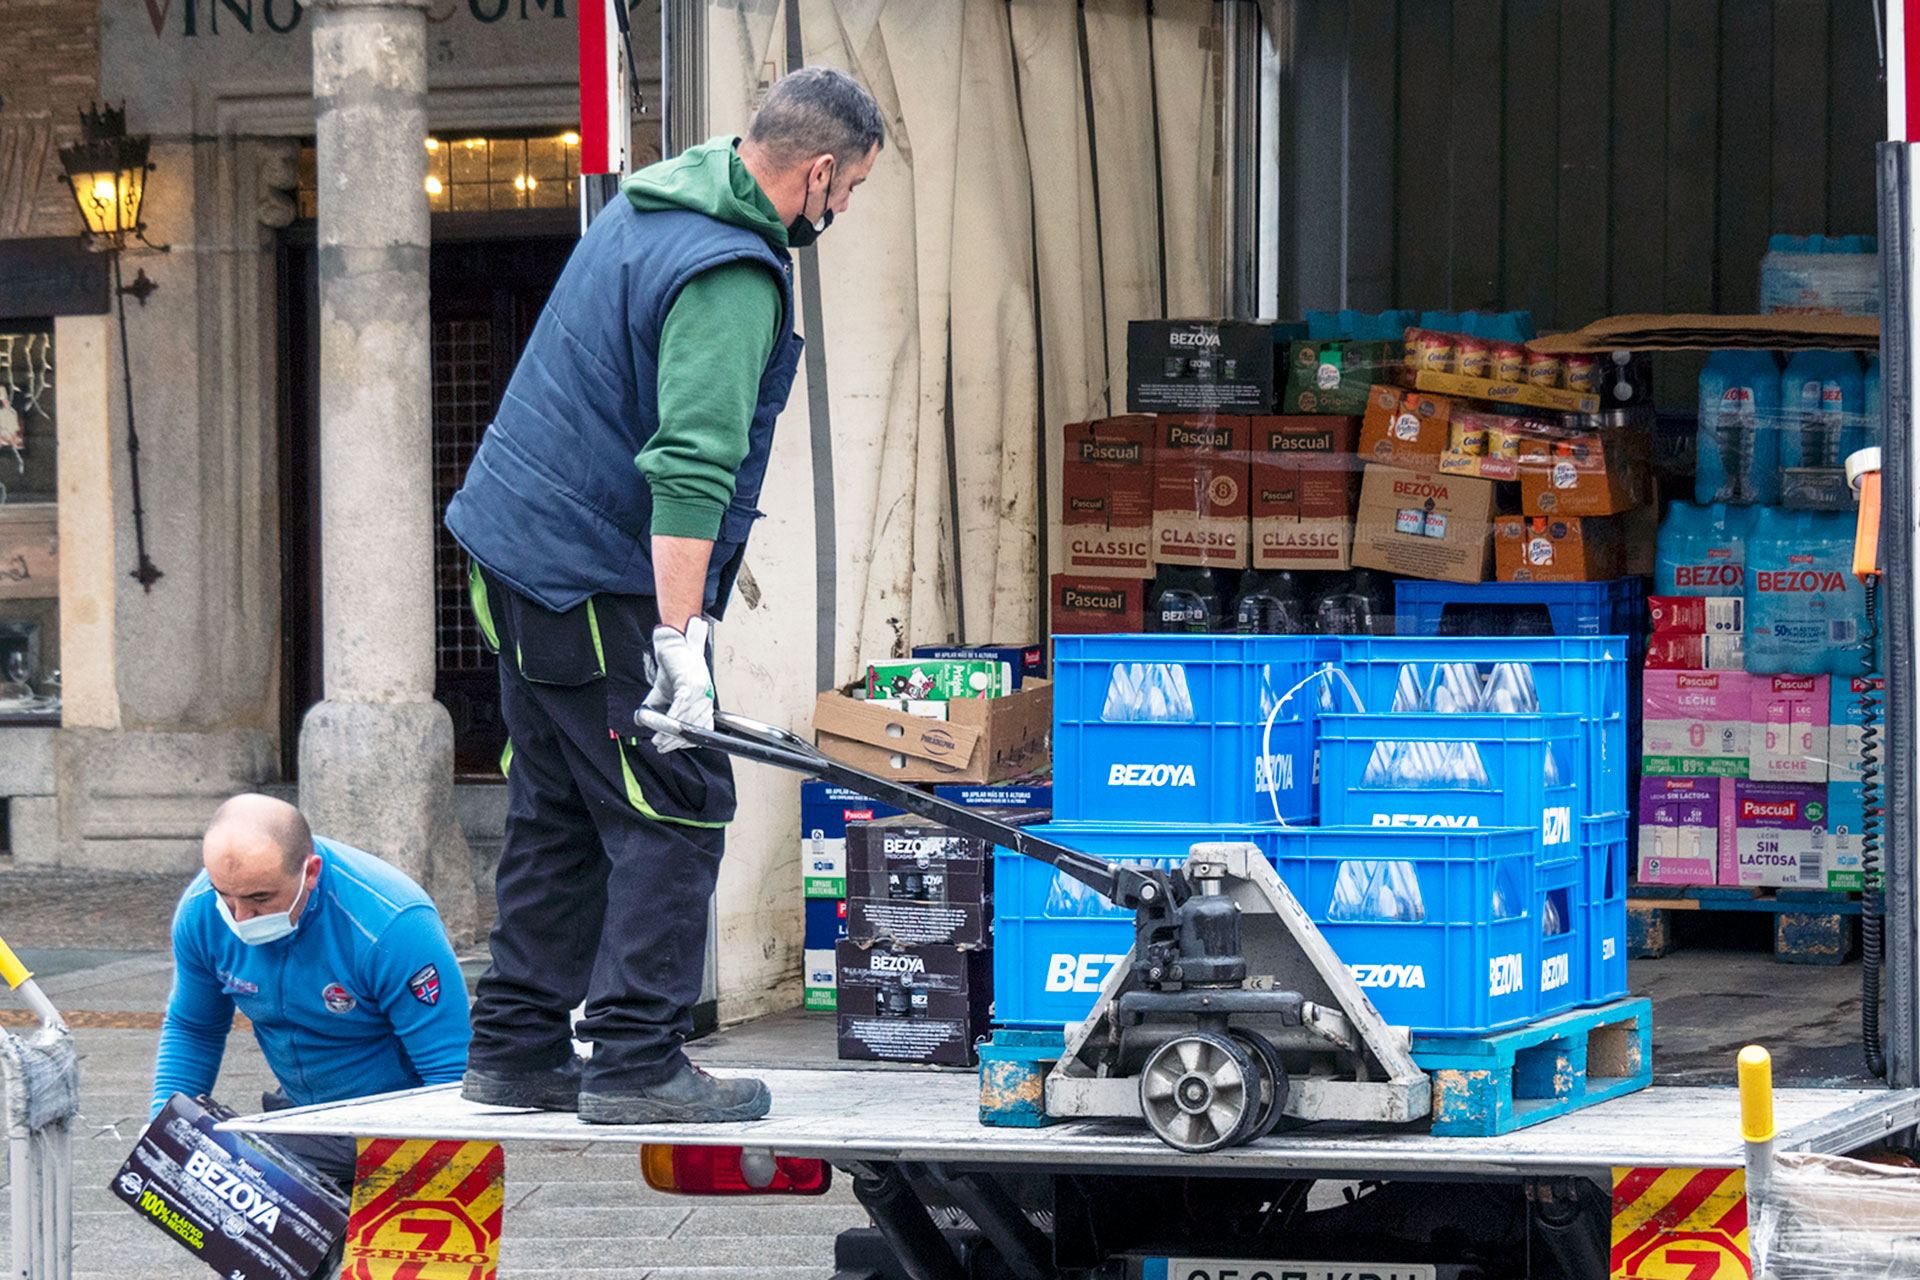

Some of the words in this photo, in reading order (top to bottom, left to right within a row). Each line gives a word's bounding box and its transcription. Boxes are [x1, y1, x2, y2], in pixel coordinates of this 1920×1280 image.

[1169, 332, 1221, 347] BEZOYA
[1171, 427, 1229, 446] Pascual
[1271, 434, 1330, 449] Pascual
[1083, 444, 1139, 460] Pascual
[1262, 490, 1293, 500] Pascual
[1393, 480, 1449, 500] BEZOYA
[1072, 499, 1102, 509] Pascual
[1161, 529, 1237, 547] CLASSIC
[1262, 532, 1339, 547] CLASSIC
[1071, 540, 1147, 556] CLASSIC
[1757, 570, 1847, 592] BEZOYA
[1065, 591, 1122, 609] Pascual
[1680, 676, 1717, 687] Pascual
[1774, 679, 1812, 689] Pascual
[1678, 696, 1717, 705] LECHE
[1768, 760, 1807, 770] LECHE
[1108, 764, 1196, 787] BEZOYA
[970, 791, 987, 799] APILAR
[1009, 791, 1031, 799] ALTURAS
[844, 811, 872, 820] Pascual
[1744, 802, 1796, 816] Pascual
[1723, 815, 1732, 869] DESNATADA
[1756, 832, 1780, 840] LECHE
[1756, 841, 1779, 853] SIN
[1739, 854, 1798, 867] LACTOSA
[1661, 866, 1710, 876] DESNATADA
[870, 956, 926, 973] BEZOYA
[1490, 952, 1523, 997] BEZOYA
[184, 1149, 281, 1235] BEZOYA
[140, 1190, 171, 1223] 100%
[170, 1211, 204, 1241] PLÁSTICO
[166, 1219, 204, 1250] RECICLADO
[352, 1247, 490, 1265] ZEPRO
